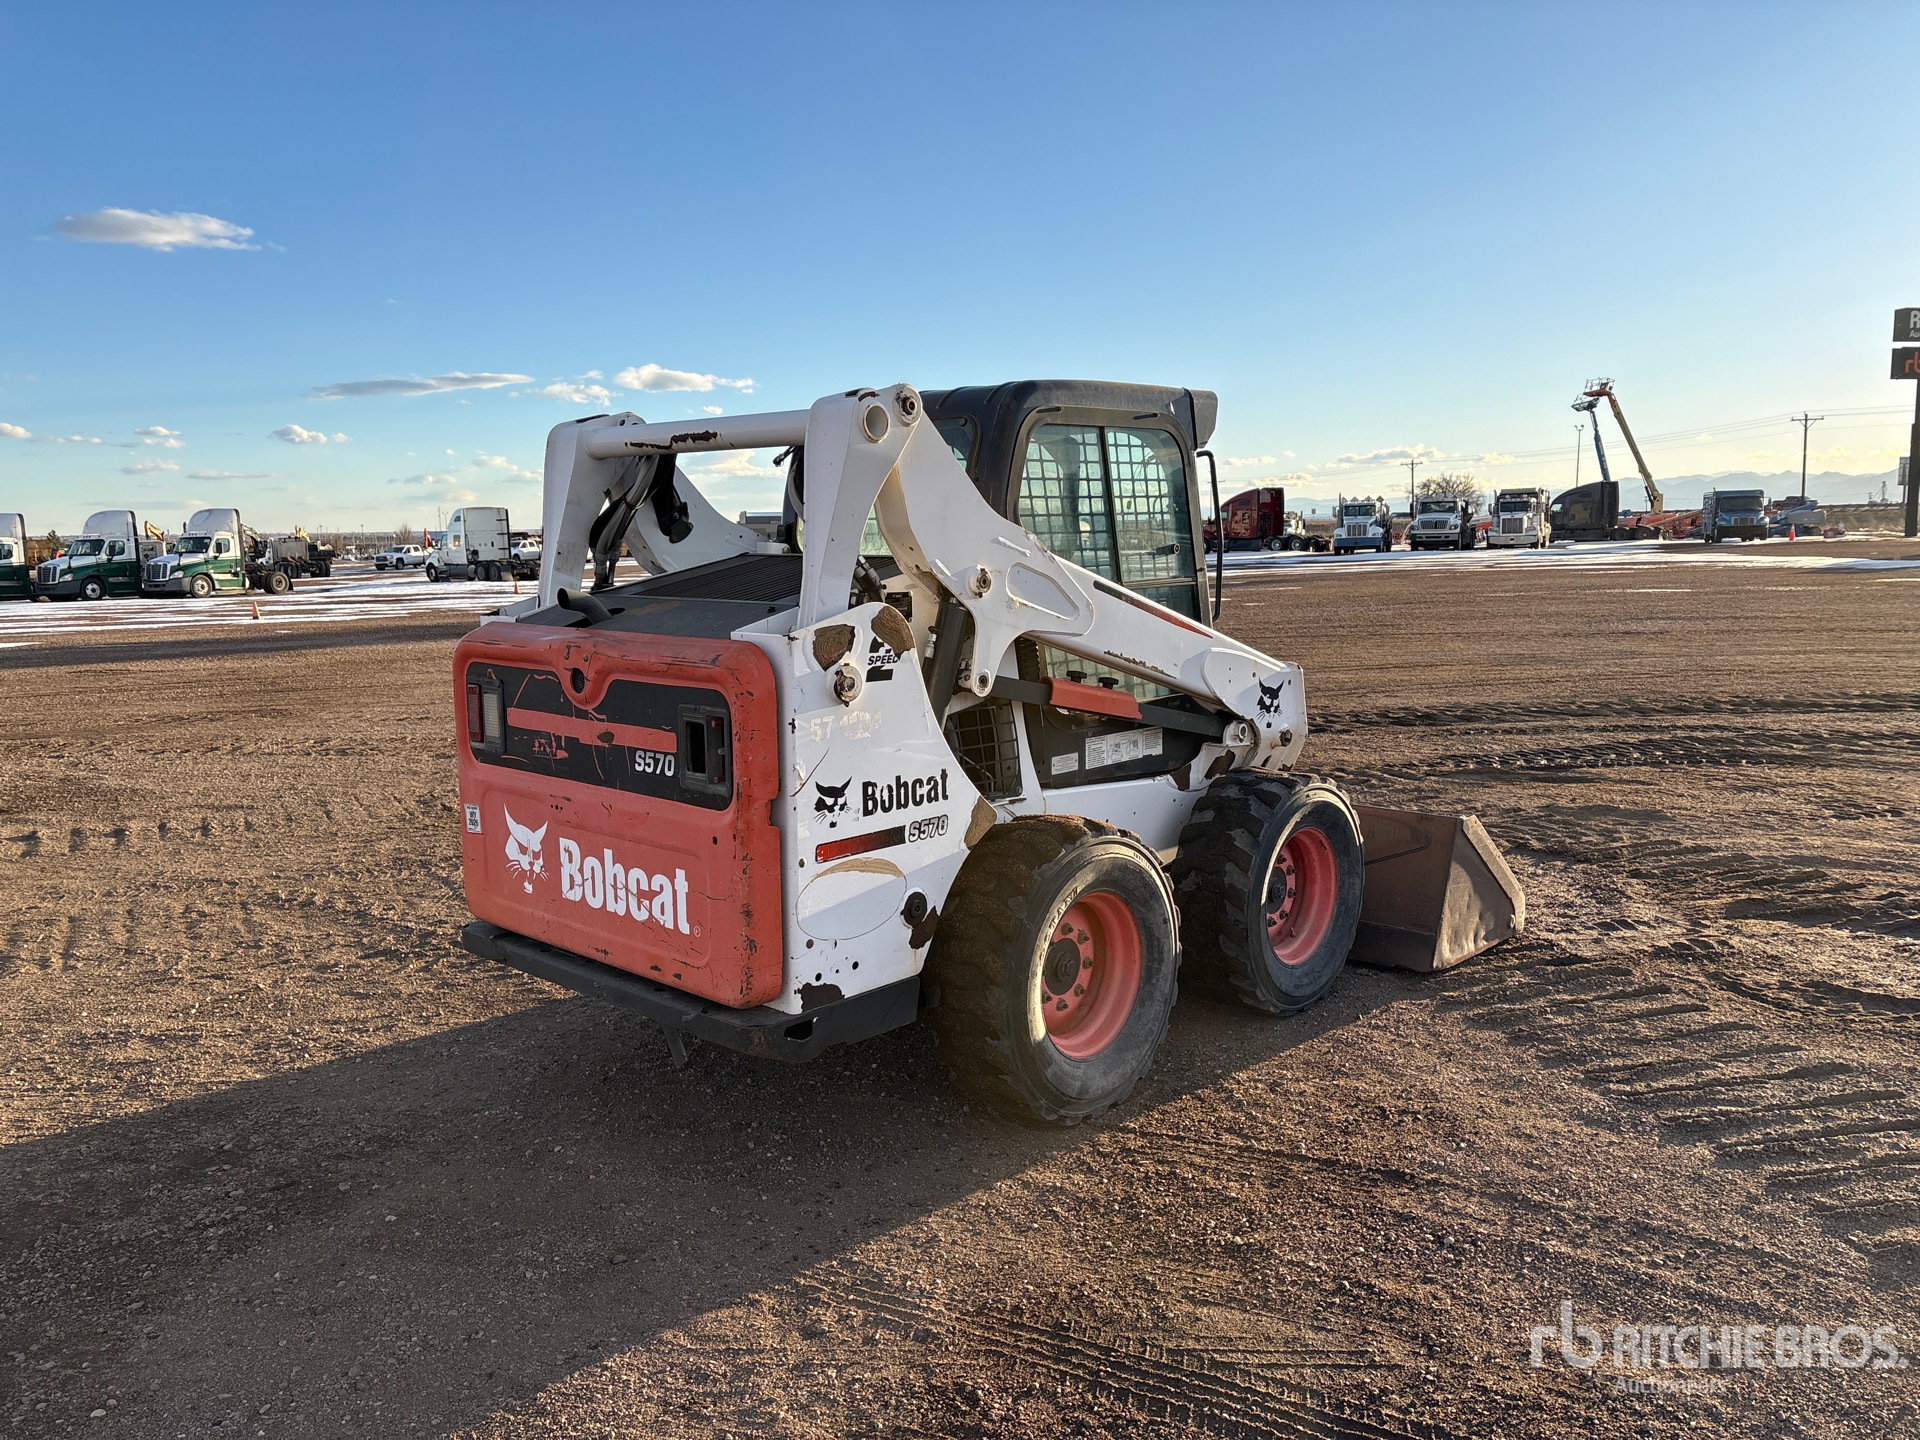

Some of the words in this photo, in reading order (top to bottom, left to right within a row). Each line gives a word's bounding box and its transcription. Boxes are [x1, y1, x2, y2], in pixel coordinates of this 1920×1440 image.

[867, 654, 899, 666] SPEED
[634, 750, 675, 777] S570
[862, 768, 949, 817] Bobcat
[908, 814, 949, 843] S570
[559, 837, 690, 935] Bobcat
